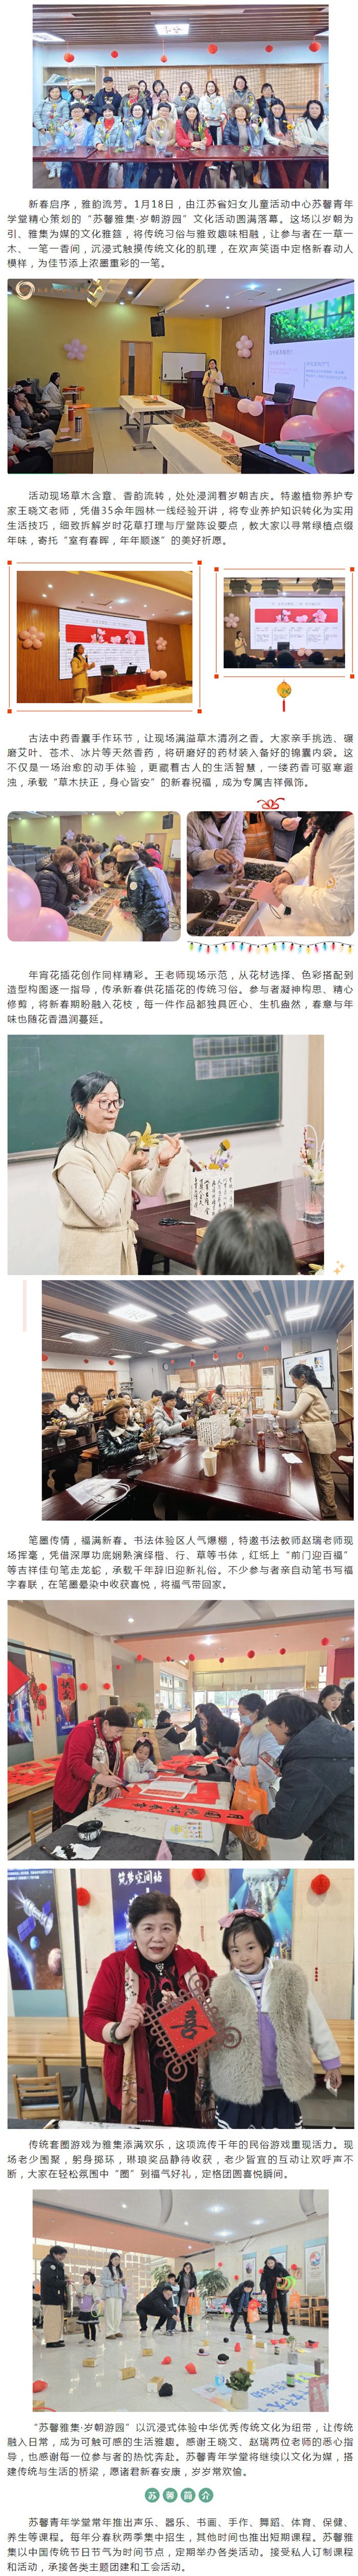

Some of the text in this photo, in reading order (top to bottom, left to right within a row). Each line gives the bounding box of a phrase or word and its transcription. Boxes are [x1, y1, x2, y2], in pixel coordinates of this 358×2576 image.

[118, 1870, 162, 1886] 筑梦空间站
[170, 2006, 208, 2040] 喜
[147, 2490, 211, 2501] 苏馨简介
